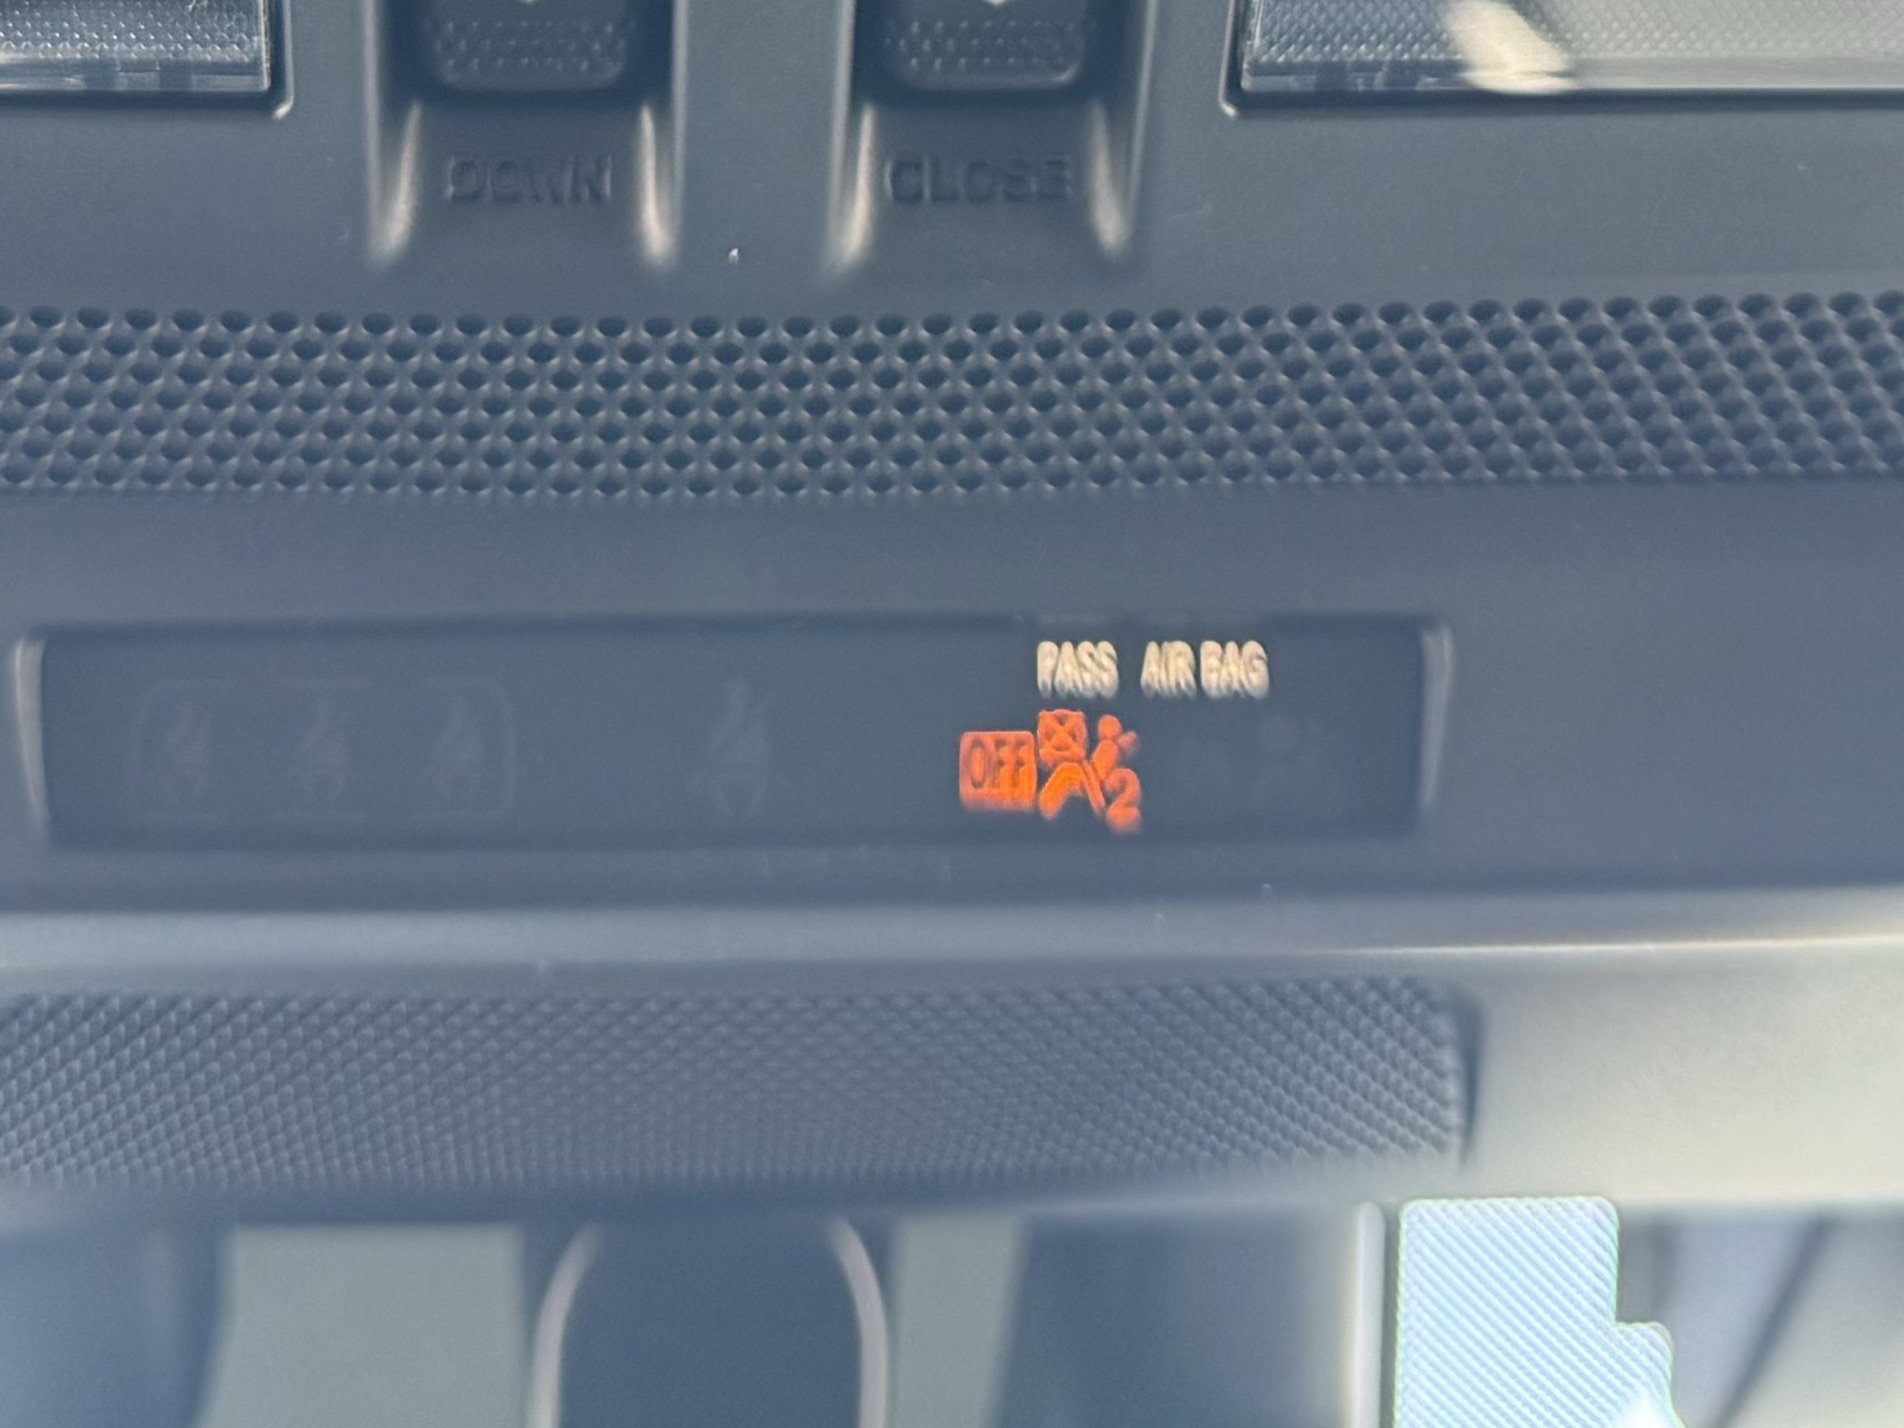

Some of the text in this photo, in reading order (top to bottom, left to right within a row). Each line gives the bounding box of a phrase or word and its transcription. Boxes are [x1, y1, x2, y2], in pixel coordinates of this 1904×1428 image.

[446, 155, 612, 204] DOWN
[883, 154, 1073, 204] CLOSE
[1036, 641, 1270, 698] PASS AIR BAG
[967, 736, 1033, 794] OFF
